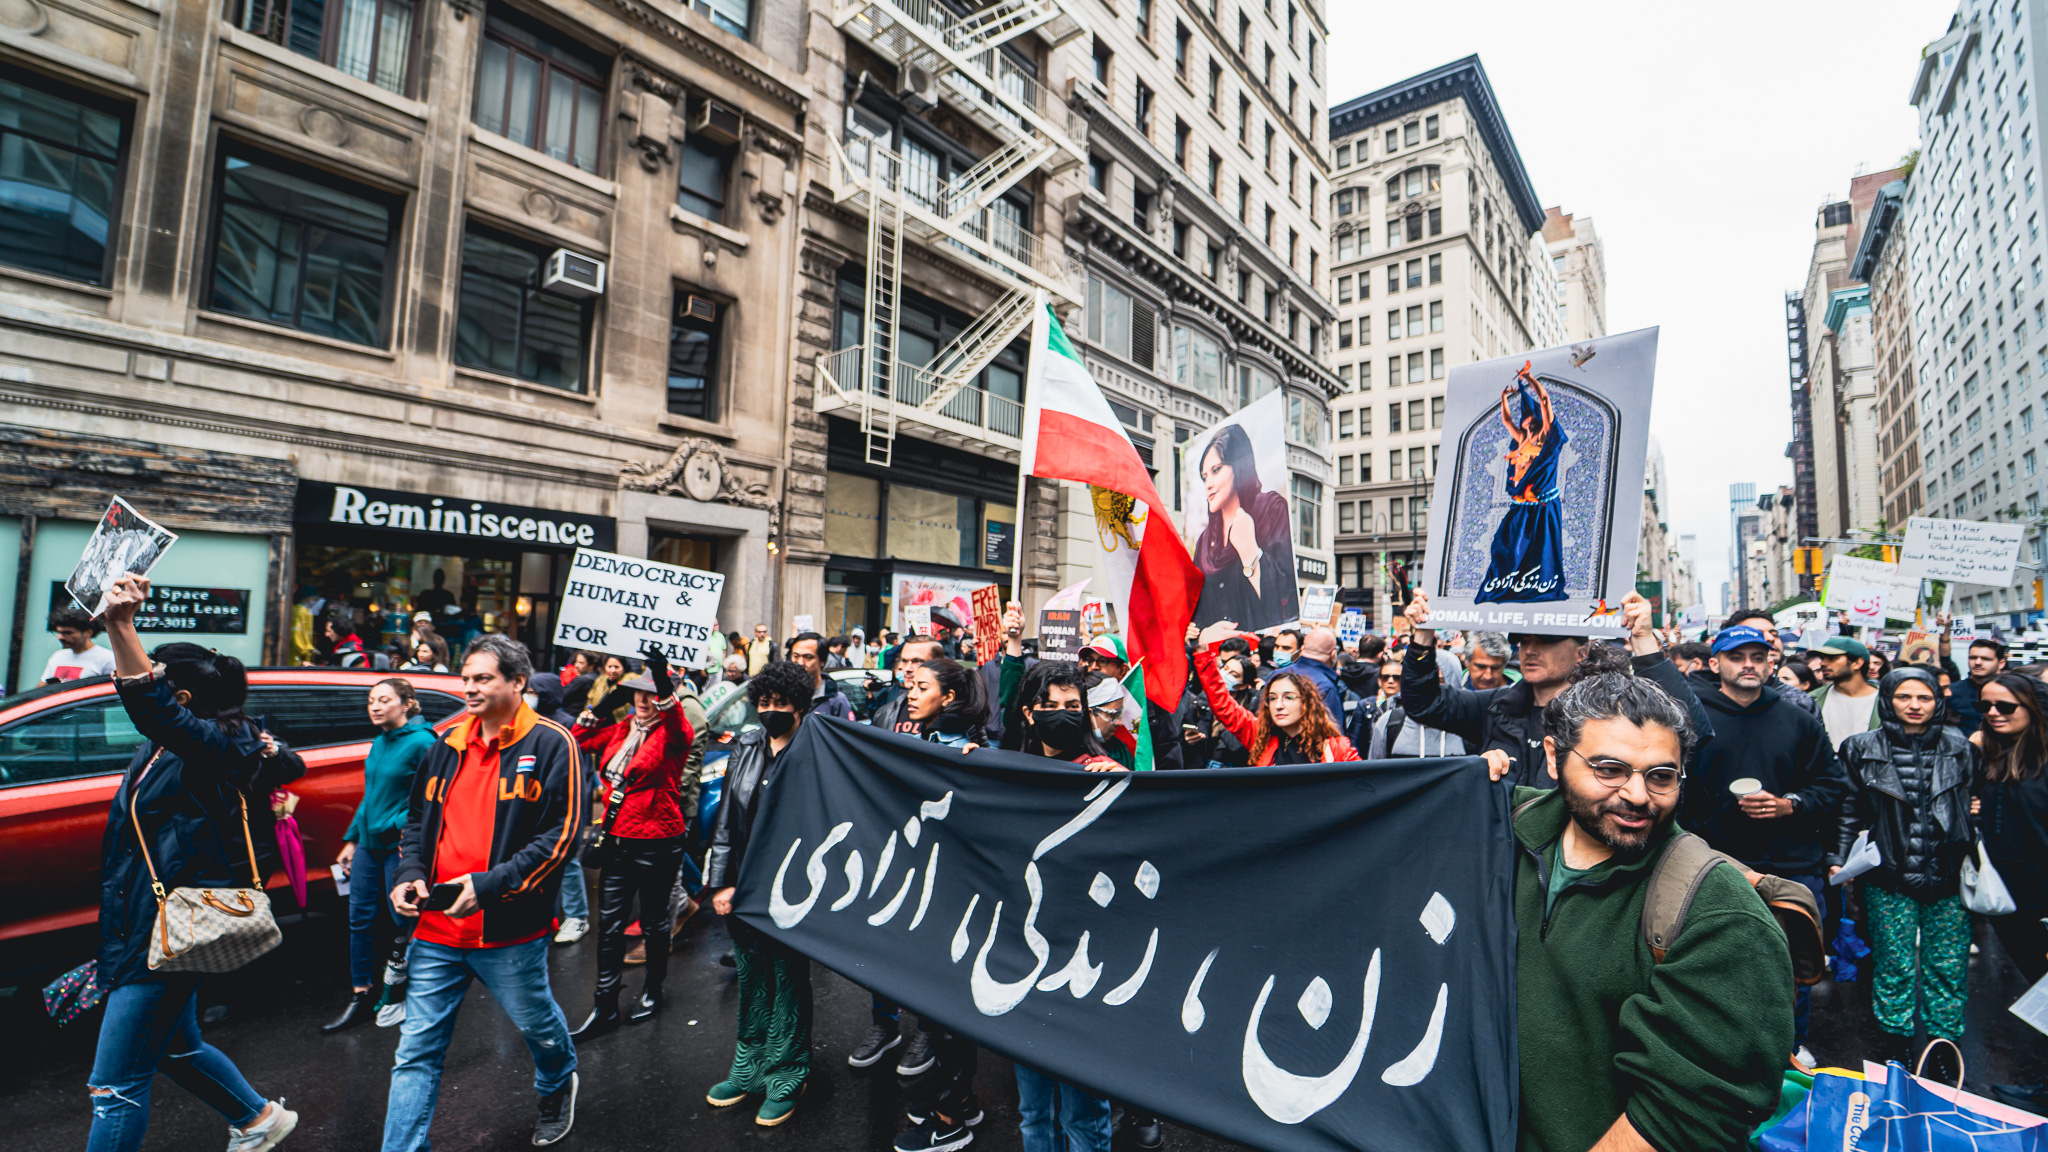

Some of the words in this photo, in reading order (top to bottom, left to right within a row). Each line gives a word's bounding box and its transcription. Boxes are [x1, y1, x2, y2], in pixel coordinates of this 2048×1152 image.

[329, 486, 595, 546] Reminiscence
[574, 553, 722, 592] DEMOCRACY
[160, 587, 210, 600] Space
[568, 580, 660, 611] HUMAN
[676, 591, 693, 607] &
[971, 585, 999, 617] FREE
[162, 601, 189, 614] for
[193, 602, 240, 615] Lease
[1854, 595, 1881, 617] زن
[1047, 611, 1071, 621] IRAN
[1533, 613, 1622, 629] FREEDOM
[559, 624, 608, 646] FOR
[622, 613, 709, 642] RIGHTS
[1041, 625, 1076, 636] WOMAN
[1046, 638, 1067, 648] LIFE
[1038, 650, 1080, 662] FREEDOM
